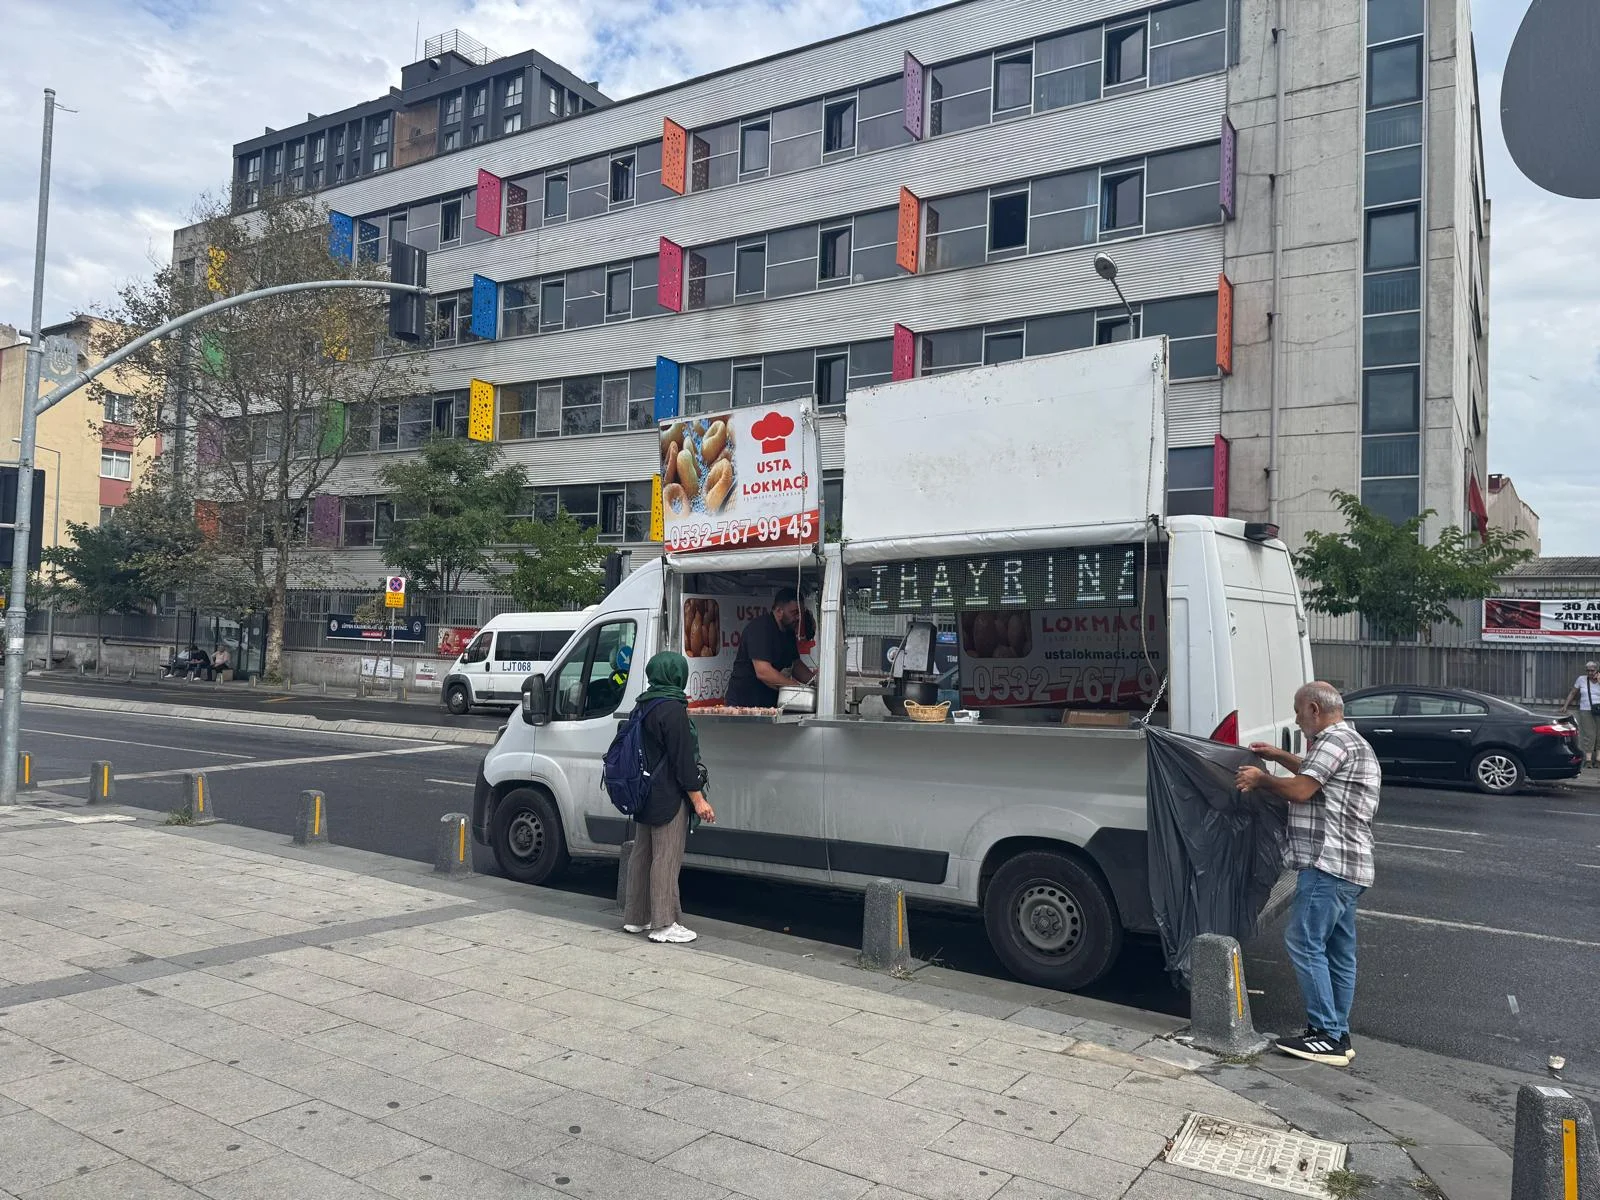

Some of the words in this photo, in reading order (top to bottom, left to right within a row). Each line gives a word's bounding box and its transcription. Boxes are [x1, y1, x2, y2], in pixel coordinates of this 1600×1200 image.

[757, 458, 792, 474] USTA
[743, 475, 809, 496] LOKMACI
[670, 522, 713, 550] 0532
[717, 518, 752, 545] 767
[757, 516, 781, 541] 99
[787, 513, 812, 539] 45
[1562, 602, 1581, 611] 30
[1042, 614, 1156, 633] LOKMACI
[1554, 612, 1600, 621] ZAFER
[1045, 648, 1160, 661] ustalokmaci.com
[502, 661, 532, 671] LJT068
[972, 665, 1051, 702] 0532
[1060, 665, 1125, 704] 767
[1137, 665, 1167, 704] 9
